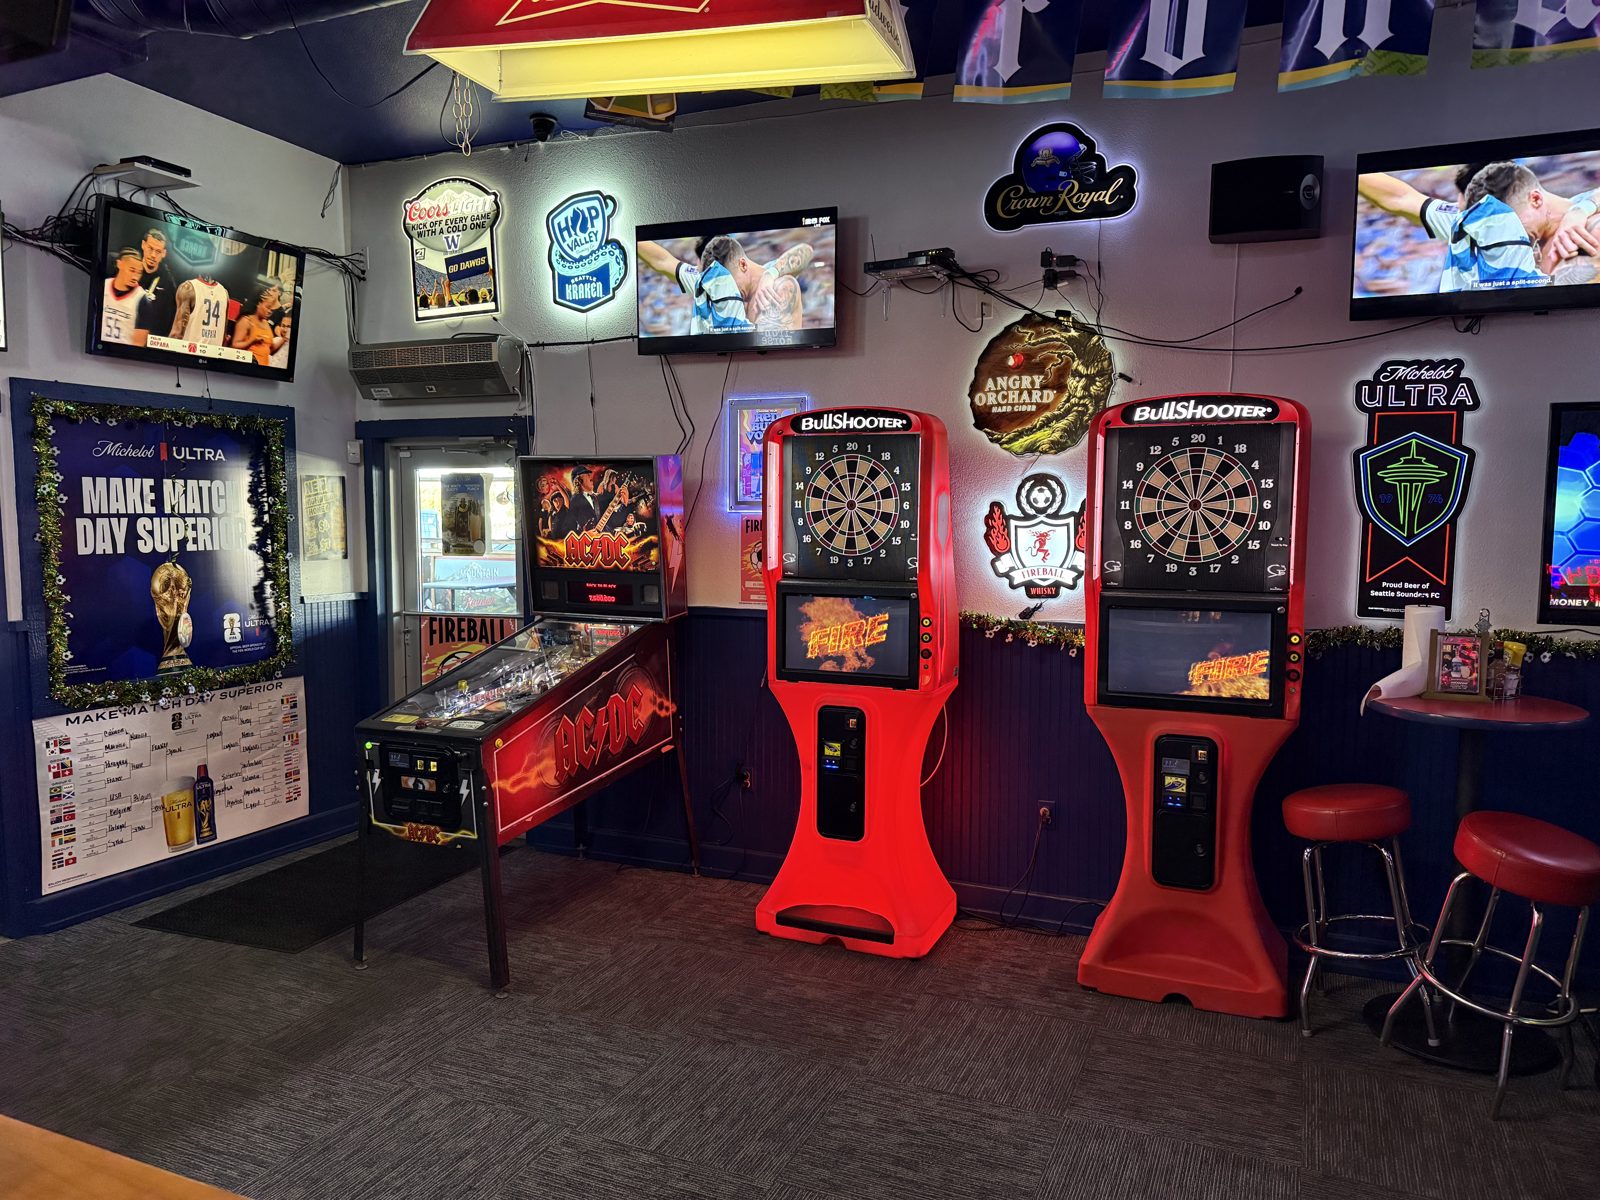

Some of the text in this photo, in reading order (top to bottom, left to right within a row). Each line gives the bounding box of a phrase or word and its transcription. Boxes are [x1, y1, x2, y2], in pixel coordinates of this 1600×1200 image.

[996, 178, 1124, 218] Crown Royal
[408, 198, 492, 222] Coors LIGHT
[412, 212, 492, 232] KICK OFF EVERY GAME
[416, 221, 486, 238] WITH A COLD ONE
[444, 234, 460, 250] W
[567, 230, 598, 252] VALLEY
[448, 256, 487, 274] GO DAWGS
[570, 275, 598, 284] SEATTLE
[1512, 278, 1552, 286] split-second.
[566, 282, 603, 300] KRAKEN
[202, 298, 220, 327] 34
[106, 316, 120, 339] 55
[1380, 364, 1458, 382] Michelob
[984, 375, 1046, 392] ANGRY
[975, 389, 1054, 406] ORCHARD
[1361, 383, 1474, 408] ULTRA
[992, 404, 1036, 413] HARD CIDER
[1172, 438, 1179, 446] 5
[1191, 434, 1205, 442] 20
[92, 440, 226, 462] Michelob ULTRA
[1234, 444, 1246, 453] 18
[1252, 461, 1259, 469] 4
[1122, 481, 1133, 489] 14
[1261, 480, 1273, 488] 13
[81, 476, 156, 514] MAKE
[1427, 494, 1444, 504] 74
[1258, 522, 1270, 530] 10
[76, 517, 248, 555] DAY SUPERIOR
[1247, 541, 1260, 549] 15
[1147, 554, 1154, 563] 7
[1231, 555, 1239, 563] 2
[460, 567, 500, 578] MOUNTAIN
[1021, 567, 1065, 580] FIREBALL
[1166, 564, 1177, 572] 19
[1209, 565, 1221, 573] 17
[1030, 586, 1056, 594] WHISKY
[244, 619, 270, 628] ULTRA
[806, 612, 889, 658] FIRE
[1189, 650, 1270, 686] FIRE
[66, 710, 118, 726] MAKE
[186, 692, 216, 708] DAY
[219, 681, 283, 700] SUPERIOR
[165, 801, 192, 813] ULTRA
